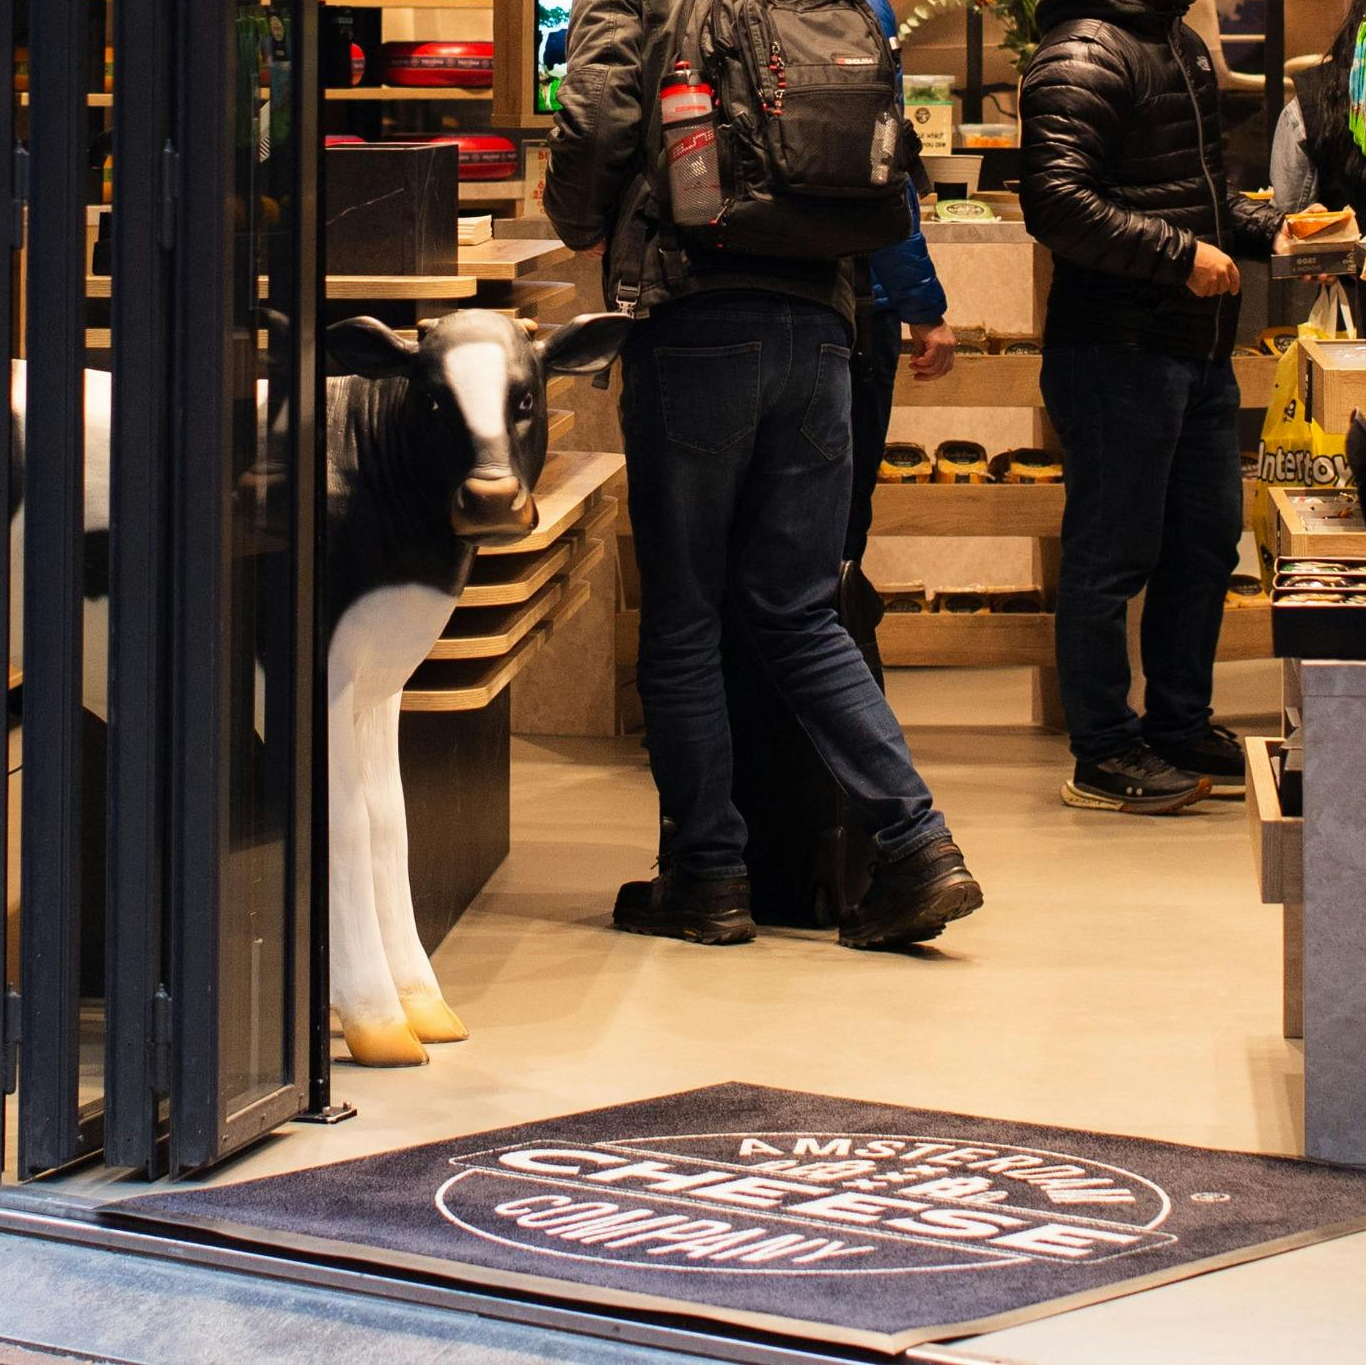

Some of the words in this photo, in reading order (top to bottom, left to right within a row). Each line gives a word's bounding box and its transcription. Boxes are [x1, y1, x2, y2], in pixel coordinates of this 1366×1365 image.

[1256, 439, 1355, 488] Intertoy
[498, 1148, 1144, 1257] CHEESE
[739, 1137, 1135, 1205] AMSTERDAM
[494, 1194, 877, 1264] COMPANY
